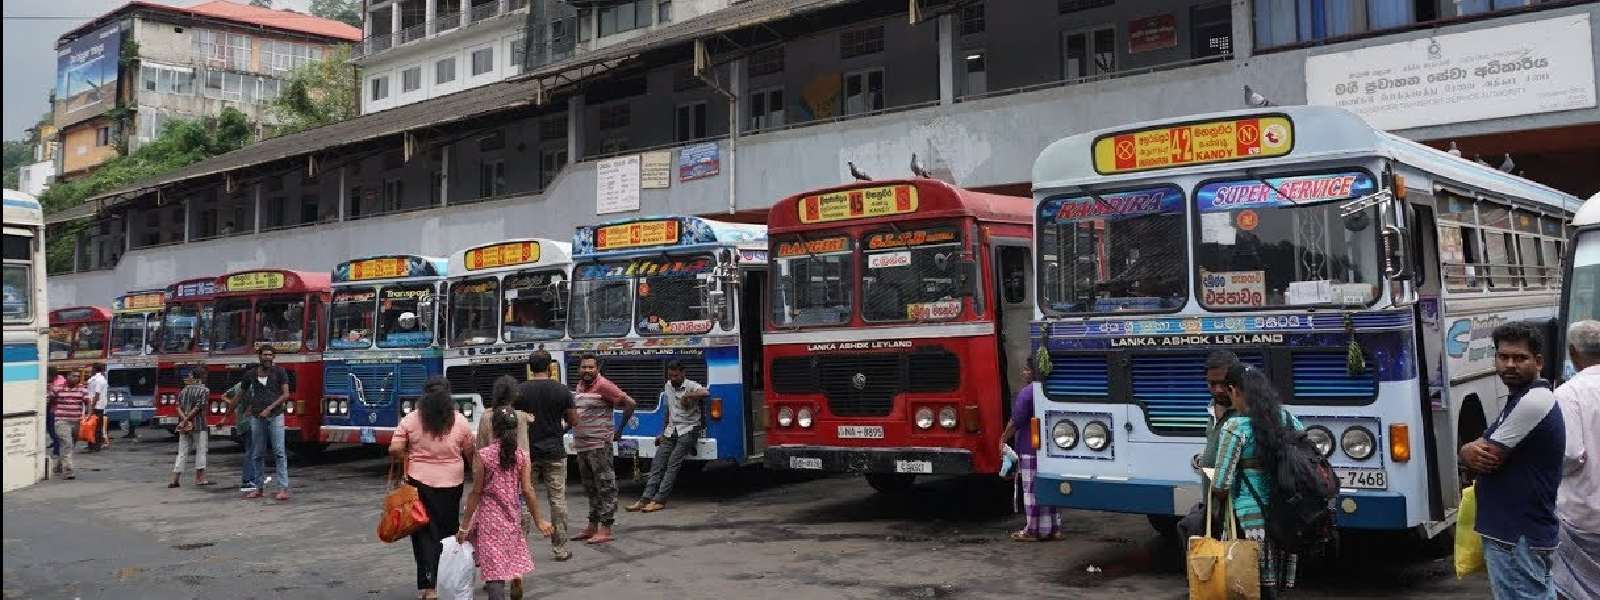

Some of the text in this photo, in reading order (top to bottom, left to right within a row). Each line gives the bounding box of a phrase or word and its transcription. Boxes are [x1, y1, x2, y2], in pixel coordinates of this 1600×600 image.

[1427, 67, 1467, 83] සේවා
[1170, 128, 1193, 163] 42
[1196, 149, 1233, 161] KANDY
[1213, 175, 1356, 206] SUPER SERVICE
[808, 340, 913, 352] LANKA ASHOK LEYLAND
[1110, 334, 1284, 347] LANKA ASHOK LEYLAND
